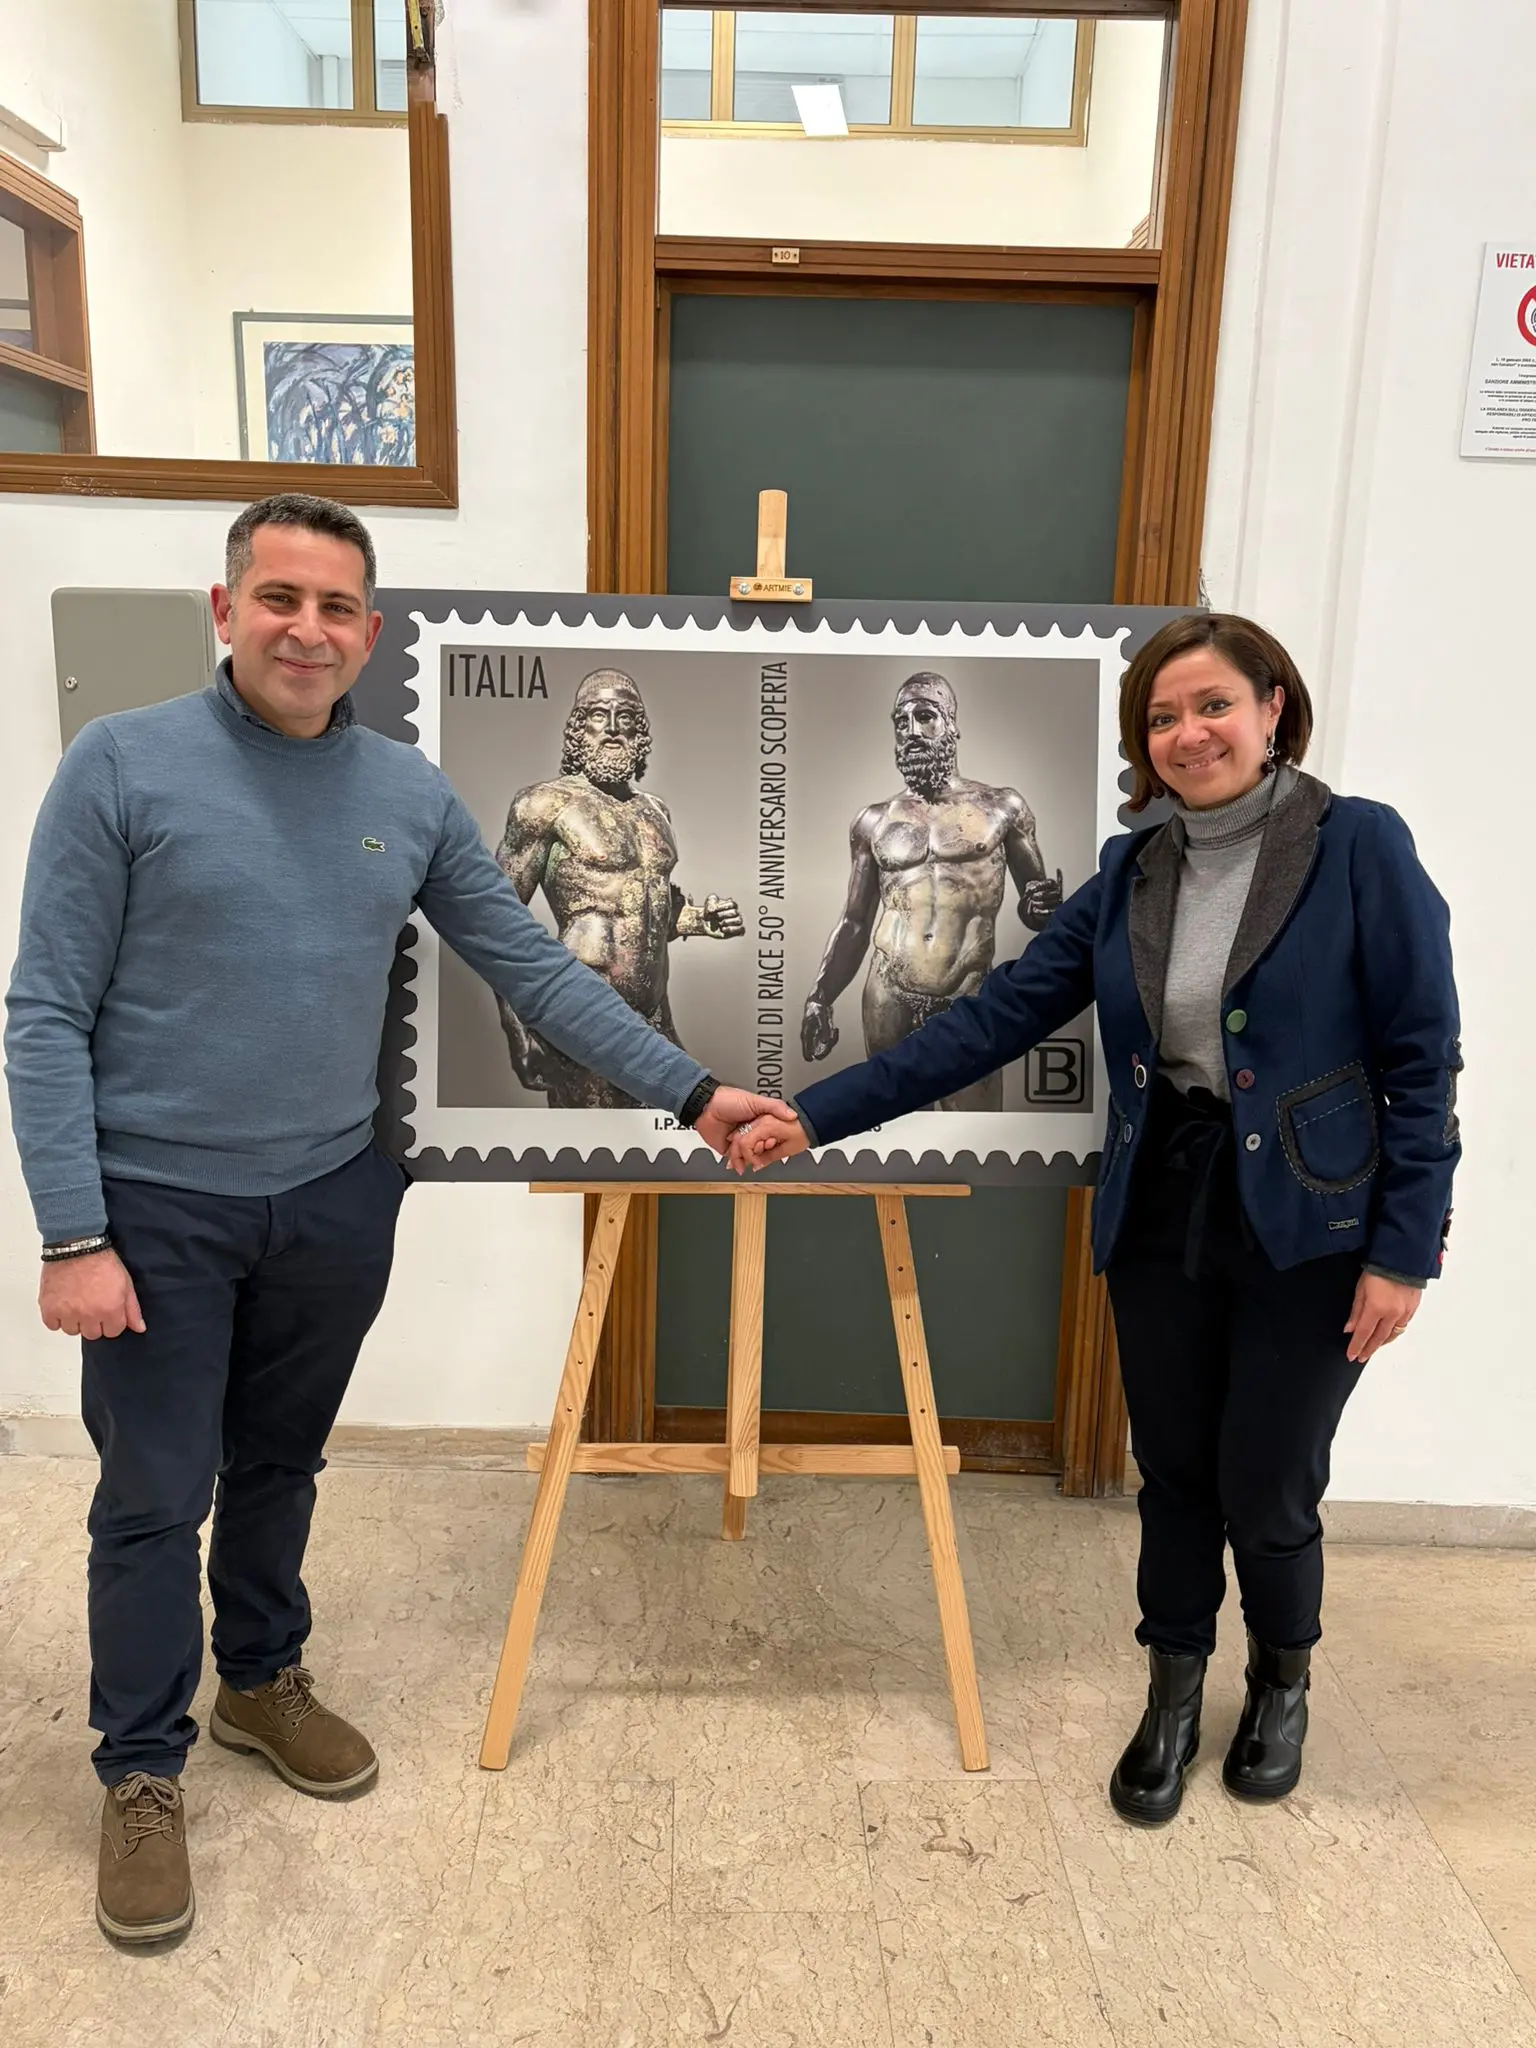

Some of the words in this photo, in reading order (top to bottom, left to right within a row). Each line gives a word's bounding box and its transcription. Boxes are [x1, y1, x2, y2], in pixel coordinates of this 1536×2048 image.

[780, 250, 791, 260] 10
[1496, 252, 1536, 269] VIETA
[763, 583, 793, 593] ARTMIE
[449, 653, 549, 699] ITALIA
[760, 661, 788, 755] SCOPERTA
[759, 762, 787, 899] ANNIVERSARIO
[758, 905, 786, 942] 50°
[757, 949, 785, 999] RIACE
[757, 1008, 784, 1025] DI
[756, 1033, 784, 1100] BRONZI
[1033, 1046, 1078, 1096] B
